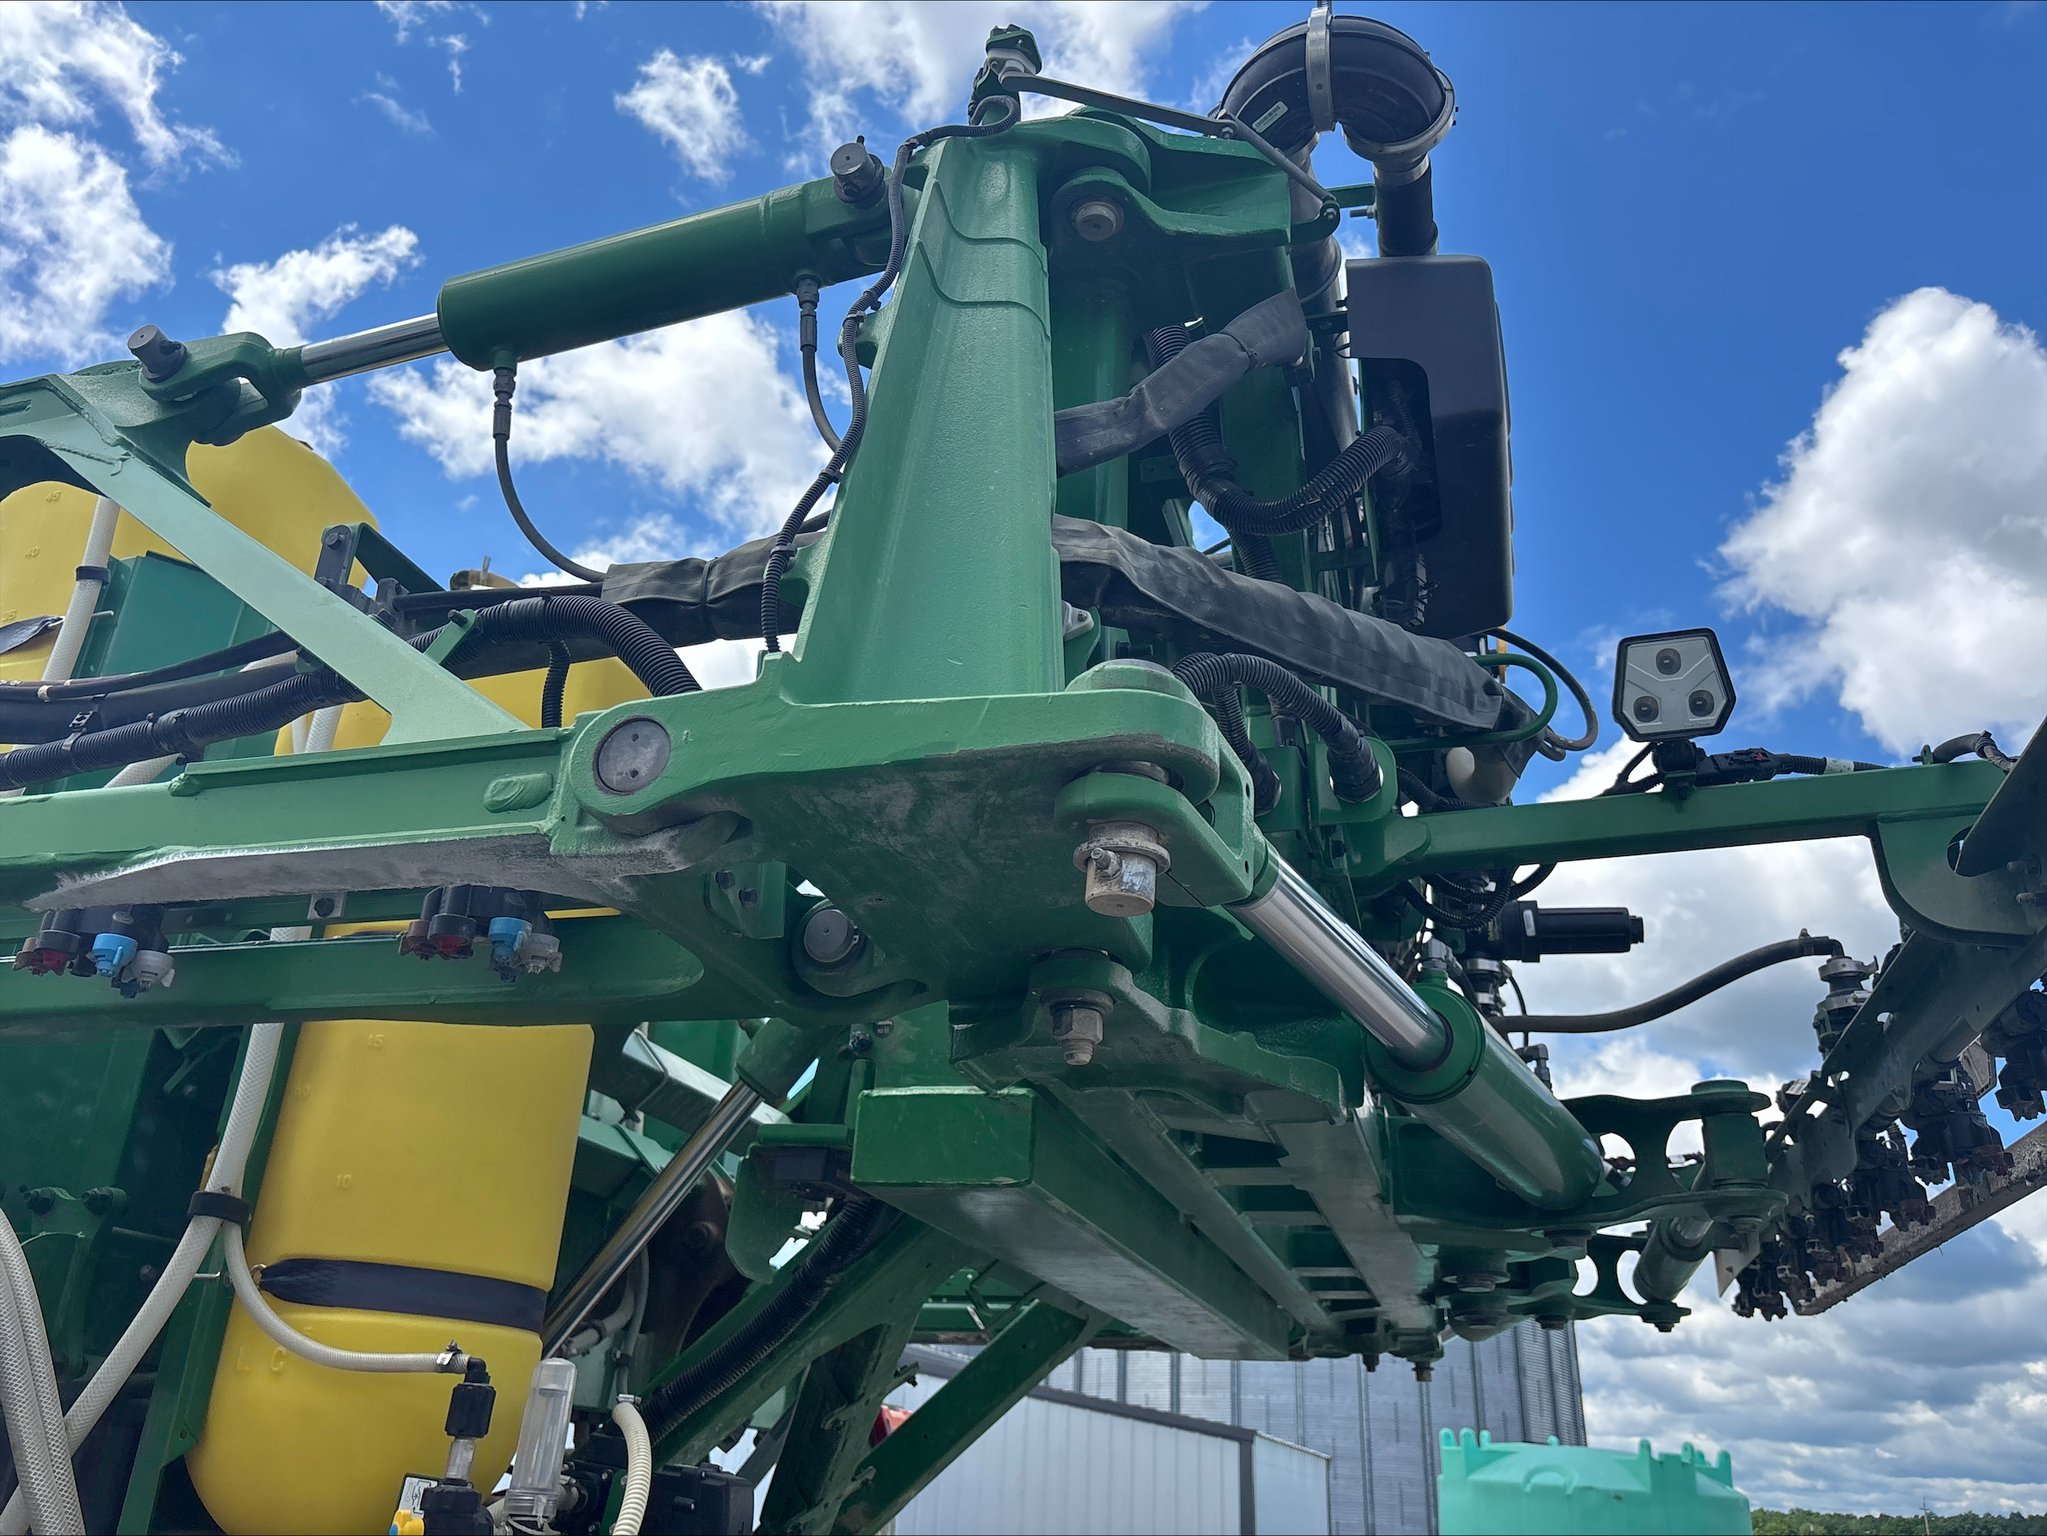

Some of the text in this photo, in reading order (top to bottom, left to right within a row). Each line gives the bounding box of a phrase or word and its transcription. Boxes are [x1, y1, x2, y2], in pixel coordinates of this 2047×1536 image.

[45, 490, 61, 503] 45
[24, 546, 40, 559] 40
[368, 1033, 385, 1048] 15
[336, 1173, 352, 1189] 10
